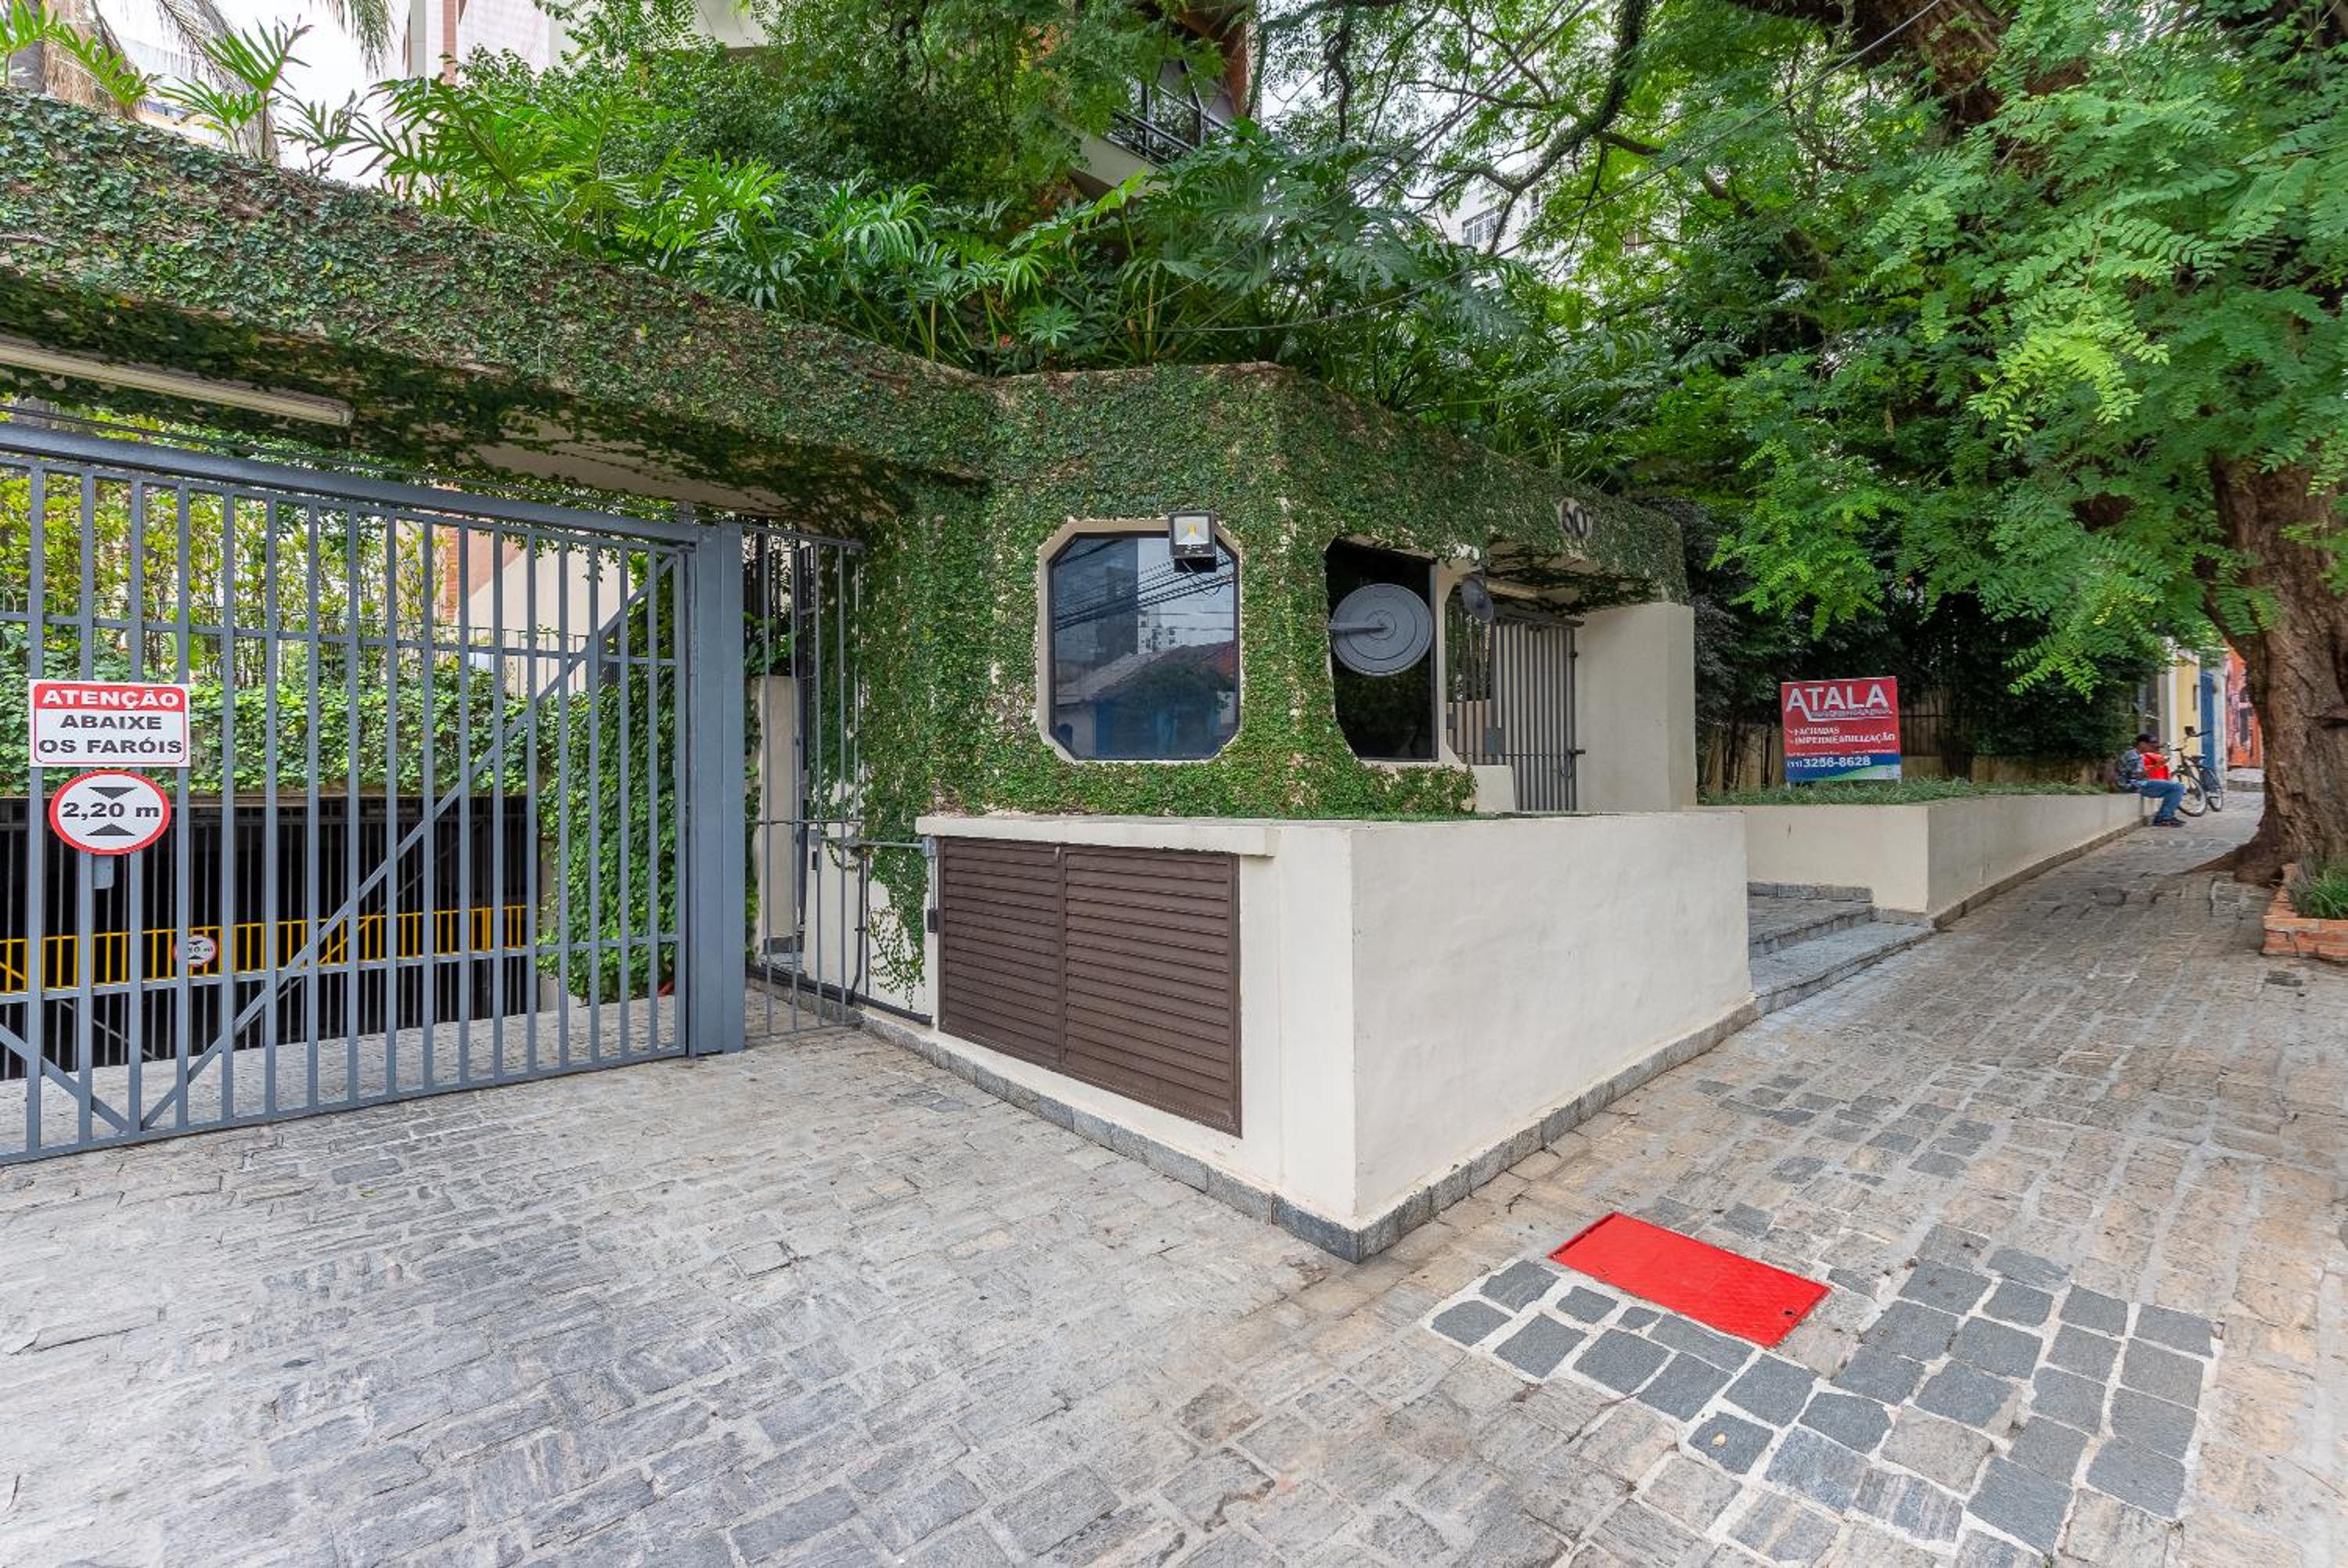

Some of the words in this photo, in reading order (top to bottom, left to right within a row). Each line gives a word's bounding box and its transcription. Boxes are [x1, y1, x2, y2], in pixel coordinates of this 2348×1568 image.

[41, 689, 179, 710] ATENÇÃO
[1785, 684, 1892, 716] ATALA
[59, 714, 162, 730] ABAIXE
[38, 739, 77, 754] OS
[87, 736, 182, 754] FARÓIS
[62, 802, 125, 821] 2,20
[135, 805, 160, 818] m
